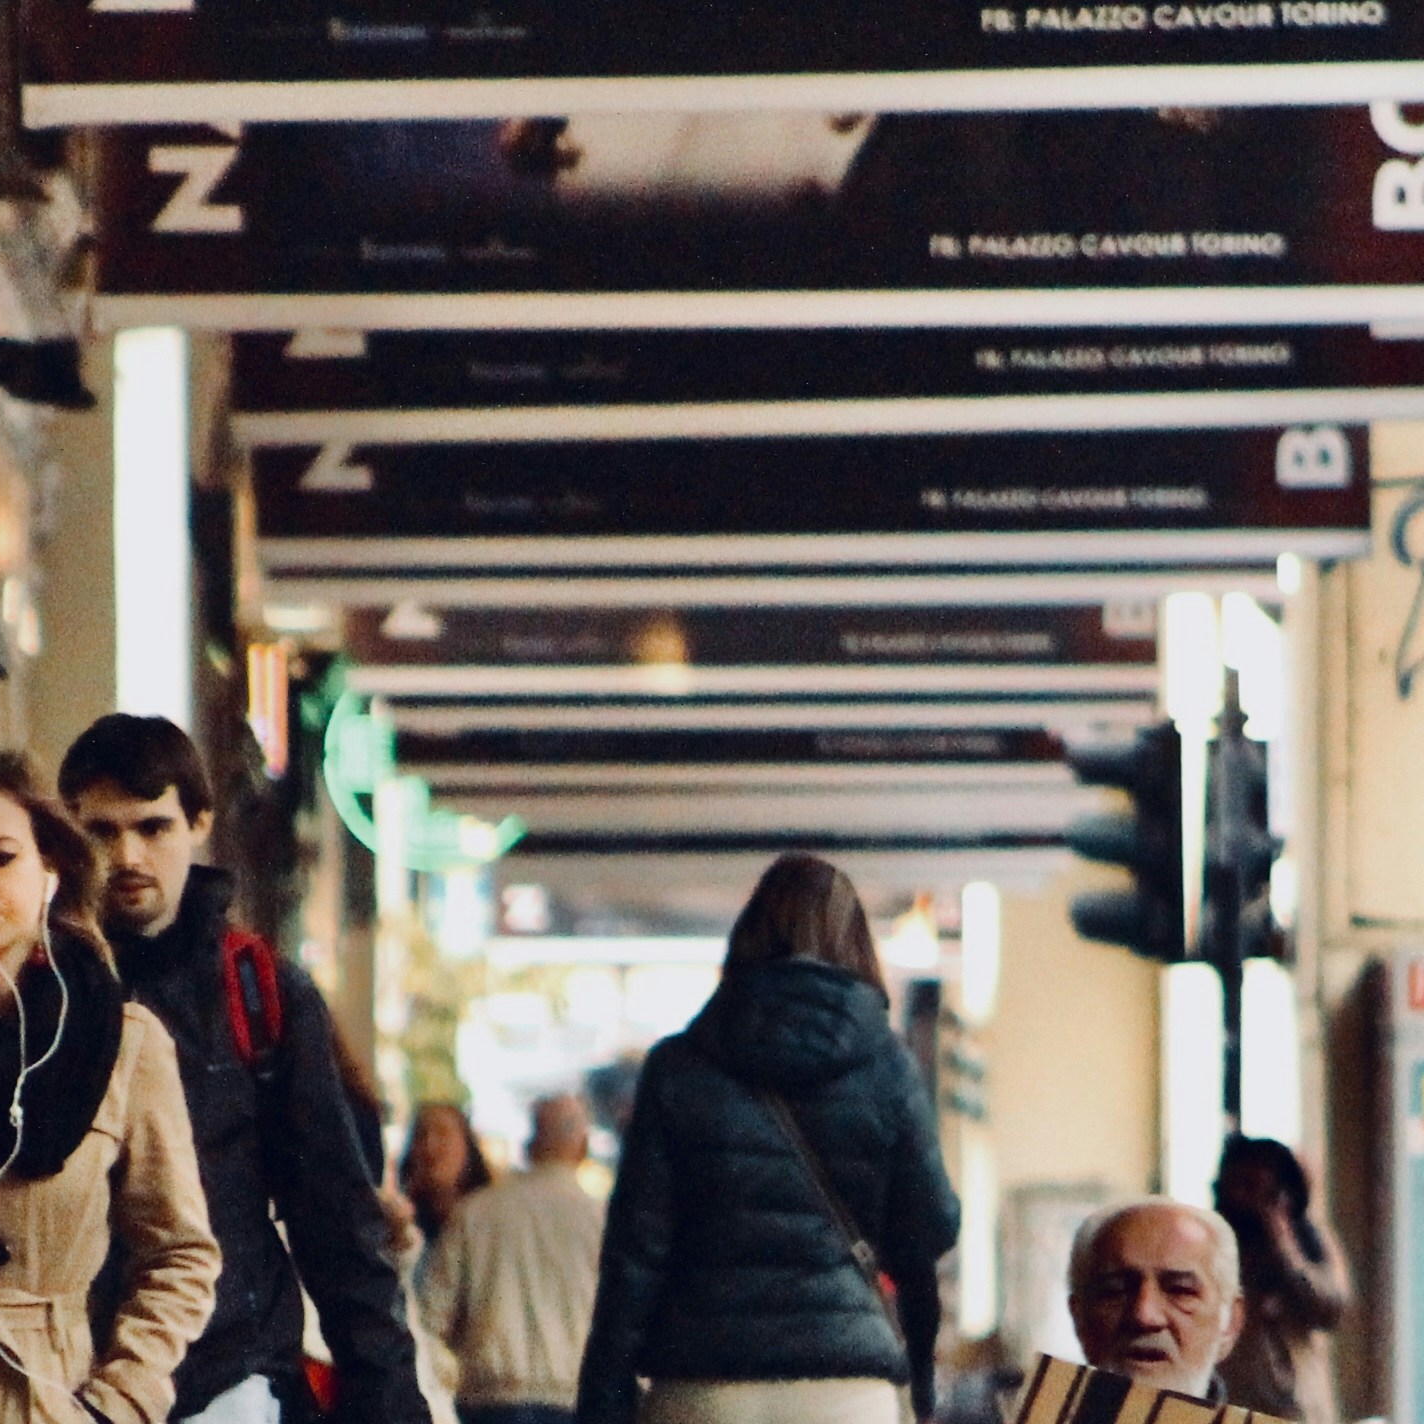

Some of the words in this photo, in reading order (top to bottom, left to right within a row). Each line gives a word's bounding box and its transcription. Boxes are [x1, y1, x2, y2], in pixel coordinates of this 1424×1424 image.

[1025, 5, 1148, 31] PALAZZO
[1152, 3, 1274, 29] CAVOUR
[1279, 0, 1387, 26] TORINO
[967, 231, 1077, 259] PALAZZO
[1078, 230, 1188, 258] CAVOUR
[1189, 229, 1287, 257] TORINO
